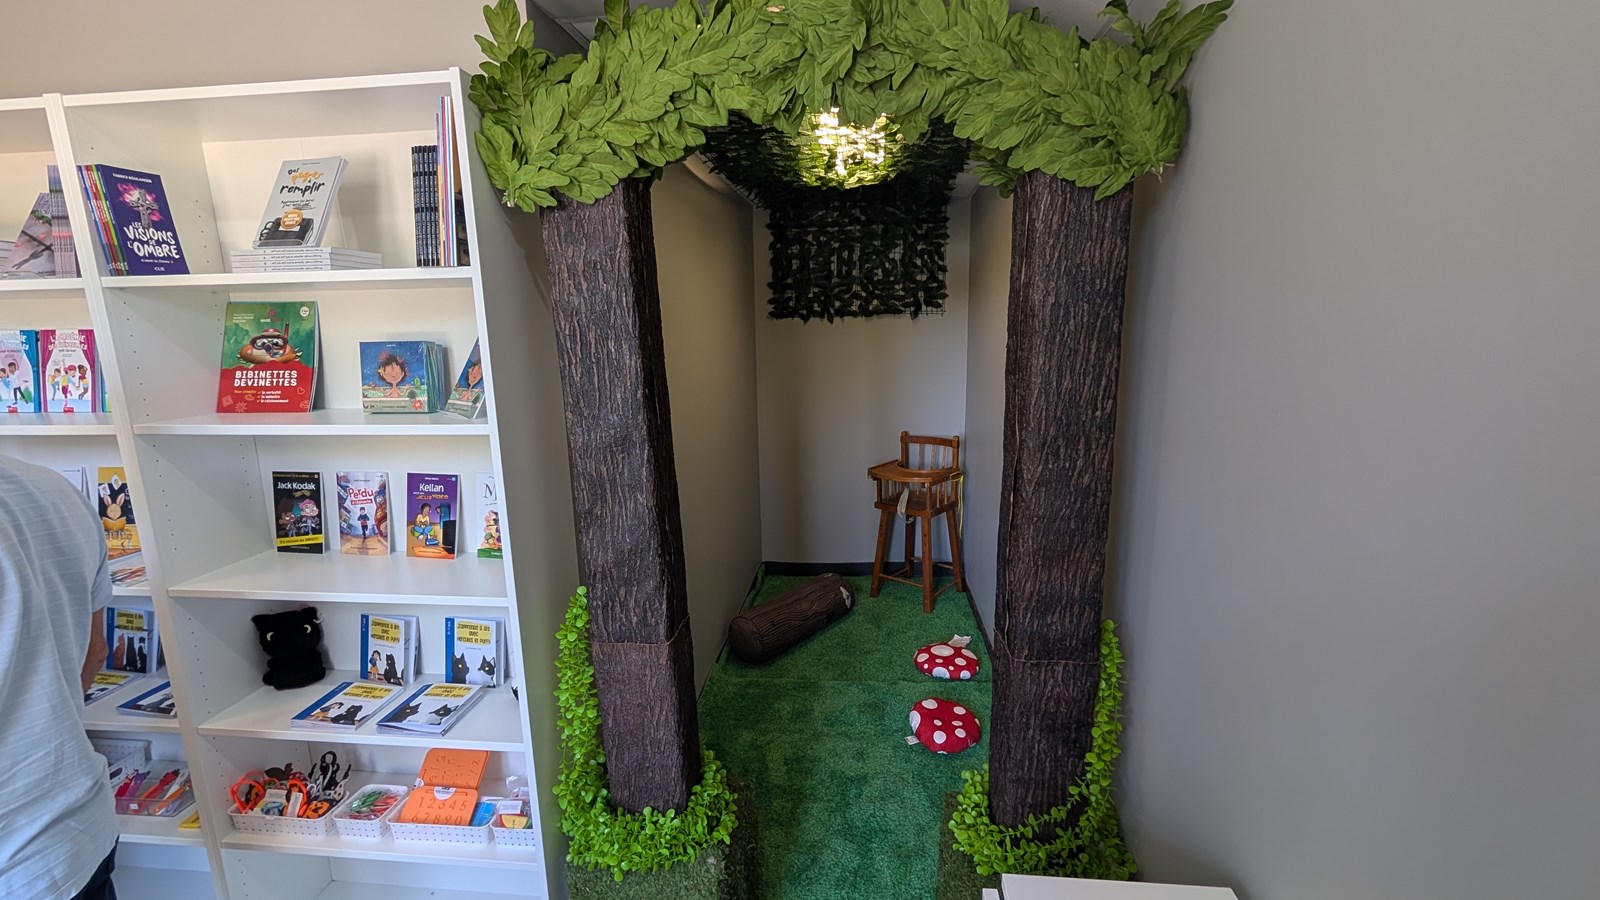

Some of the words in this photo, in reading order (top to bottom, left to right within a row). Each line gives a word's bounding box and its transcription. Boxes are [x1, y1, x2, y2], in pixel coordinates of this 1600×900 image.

[279, 181, 325, 198] remplir
[131, 221, 142, 229] LES
[123, 226, 176, 245] VISIONS
[127, 241, 180, 259] L'OMBRE
[235, 370, 298, 379] BIBINETTES
[234, 378, 297, 387] DEVINETTES
[277, 481, 292, 490] Jack
[292, 481, 316, 490] Kodak
[419, 482, 444, 493] Kellan
[347, 487, 374, 499] Perdu
[449, 800, 456, 811] 4
[459, 801, 468, 811] 5
[423, 812, 432, 823] 7
[433, 813, 441, 824] 8
